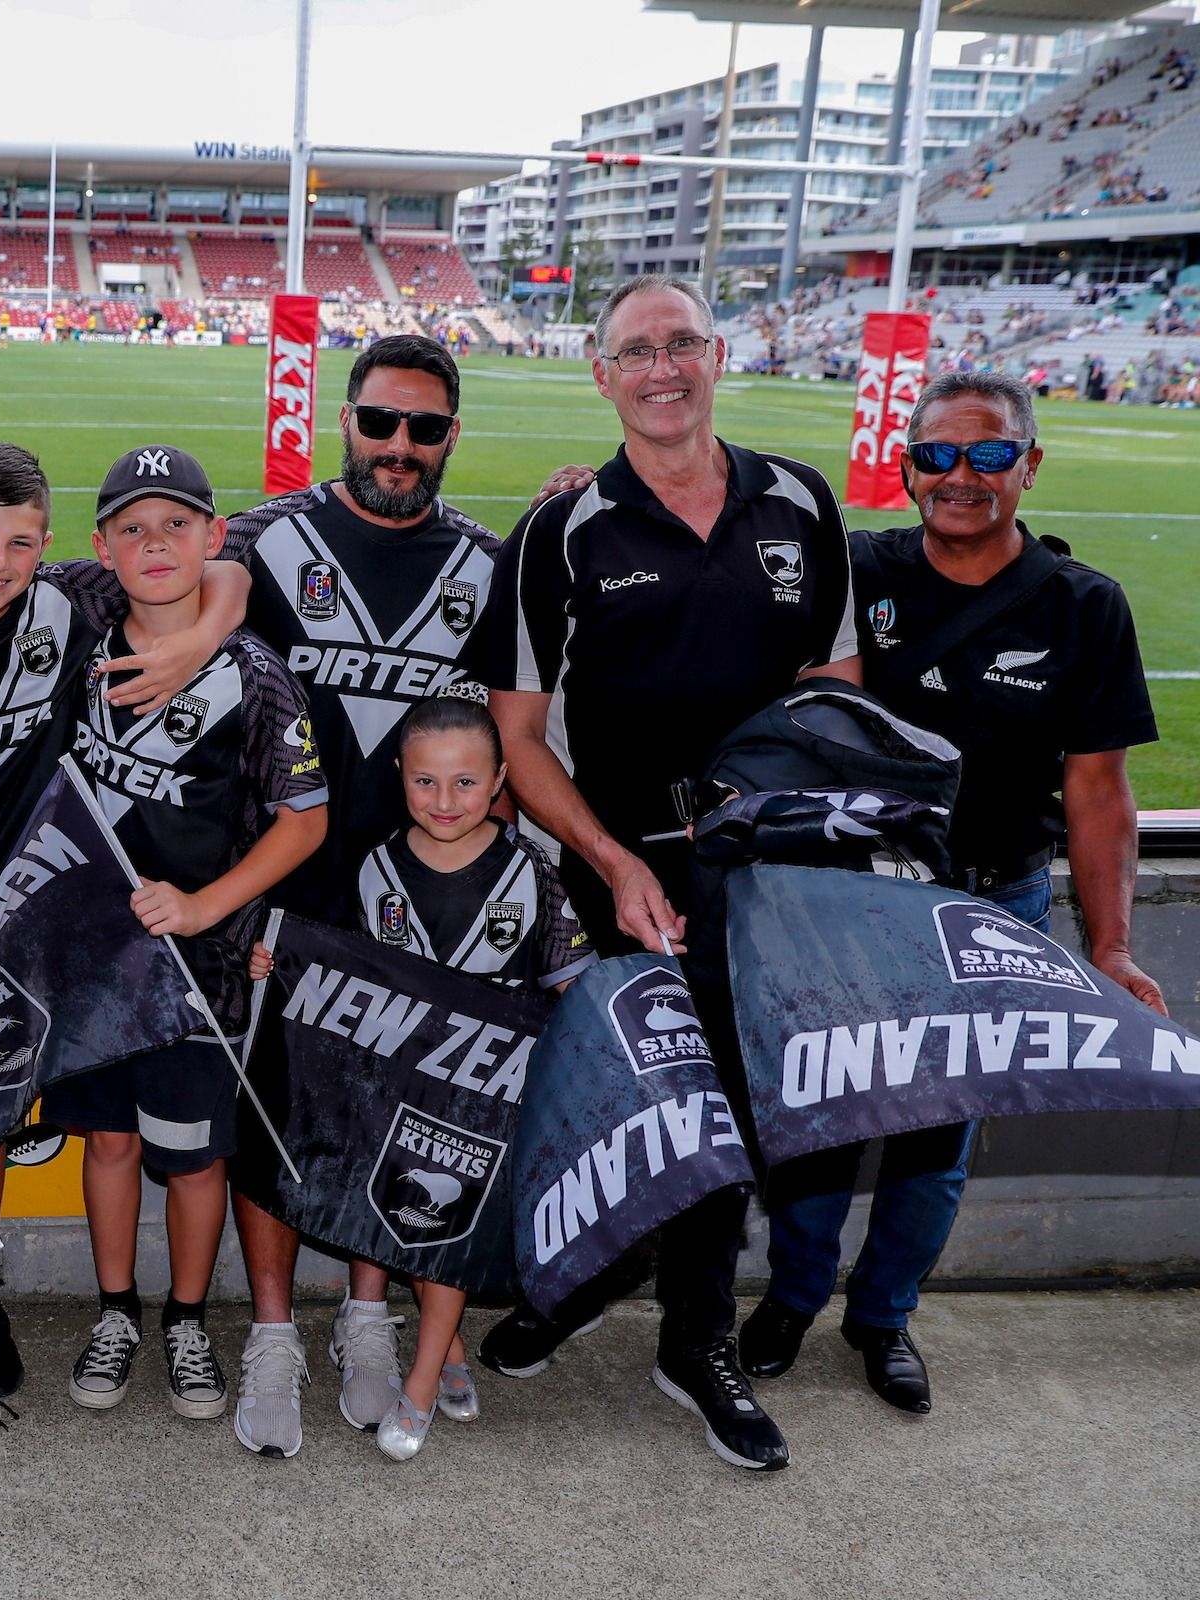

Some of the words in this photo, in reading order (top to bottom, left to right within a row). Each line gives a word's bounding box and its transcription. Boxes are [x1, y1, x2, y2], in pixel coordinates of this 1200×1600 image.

[194, 142, 235, 158] WIN
[271, 334, 313, 457] KFC
[851, 350, 889, 467] KFC
[600, 571, 660, 592] KooGa
[443, 586, 475, 602] KIWIS
[775, 593, 800, 603] KIWIS
[19, 633, 52, 652] KIWIS
[287, 645, 467, 697] PIRTEK
[983, 671, 1002, 682] ALL
[170, 698, 204, 716] KIWIS
[488, 909, 521, 919] KIWIS
[959, 950, 1081, 980] KIWIS
[964, 964, 1044, 977] ZEALAND
[1049, 972, 1085, 987] NEW
[281, 961, 432, 1058] NEW
[644, 1047, 712, 1062] EALAND
[781, 1010, 1121, 1109] ZEALAND
[403, 1116, 431, 1138] NEW
[431, 1128, 493, 1161] ZEALAND
[395, 1127, 490, 1180] KIWIS
